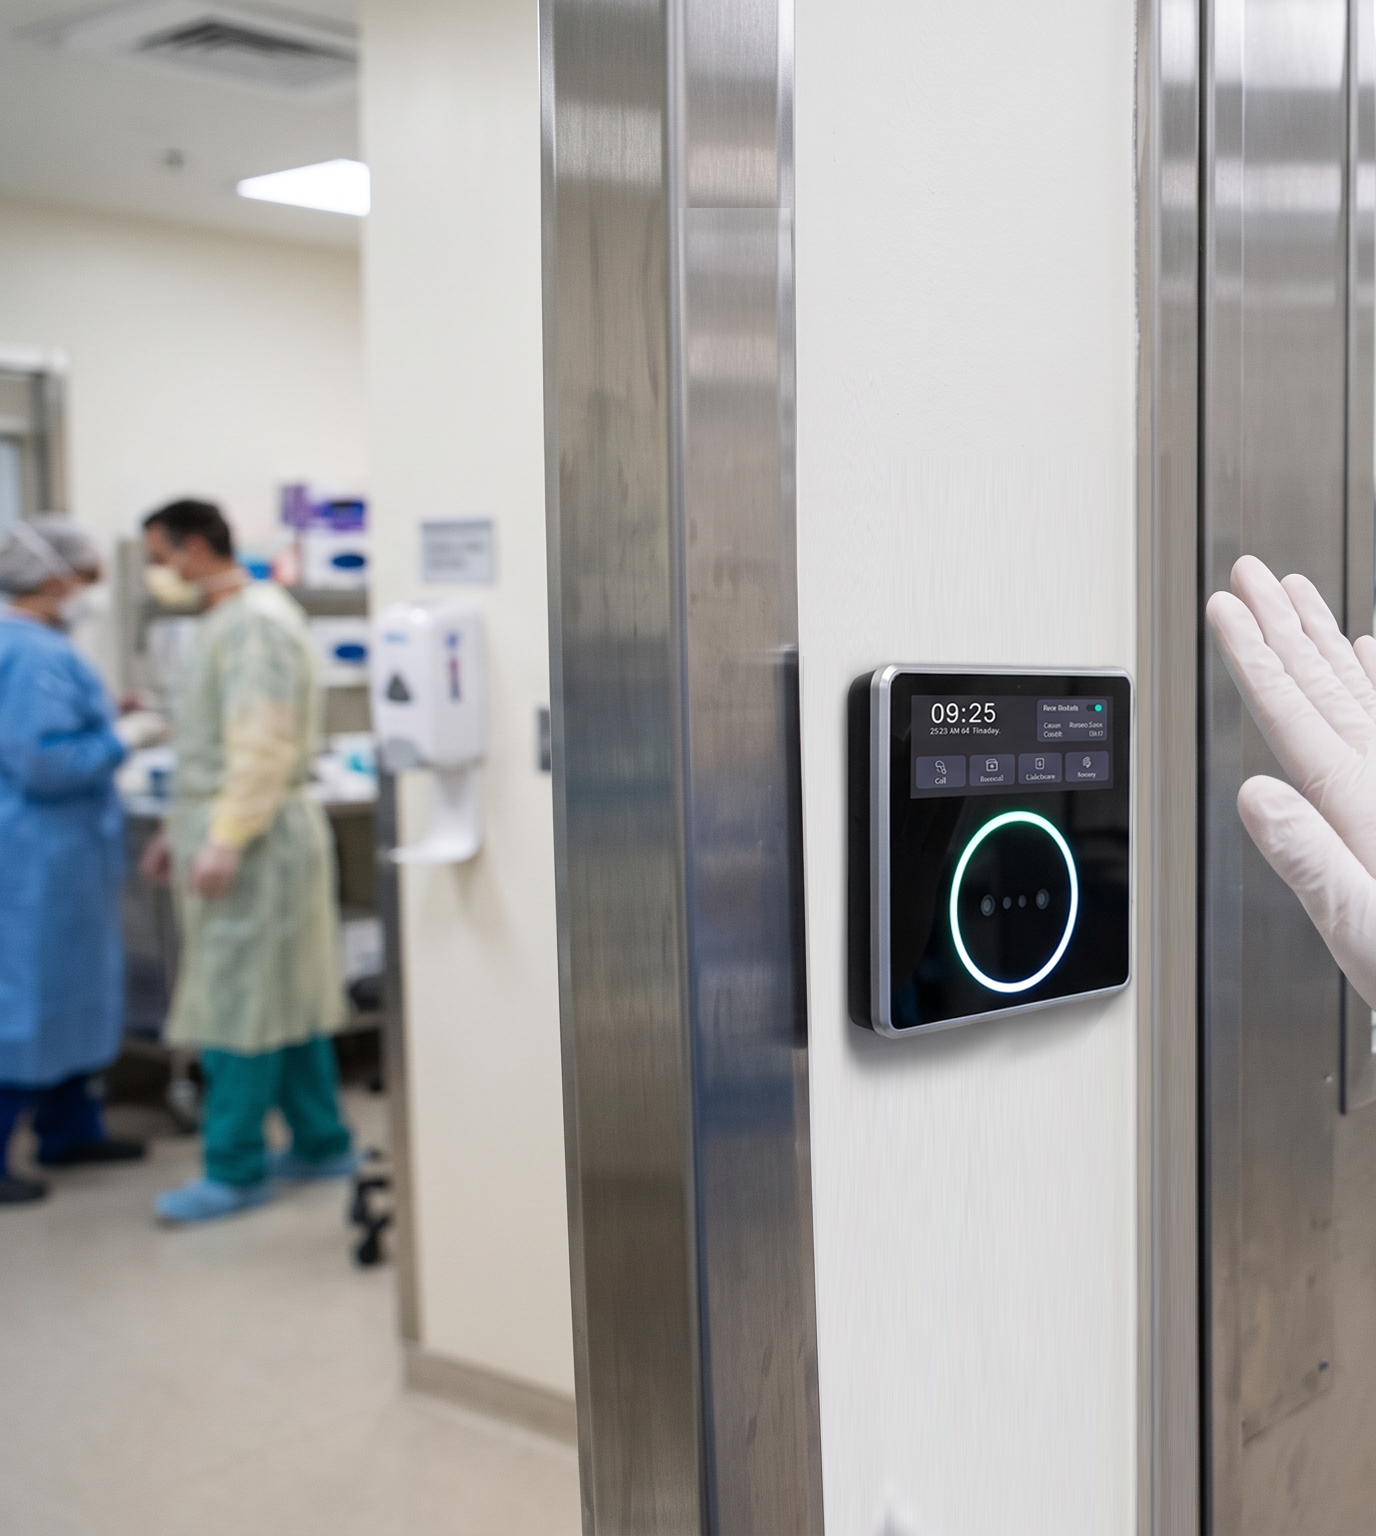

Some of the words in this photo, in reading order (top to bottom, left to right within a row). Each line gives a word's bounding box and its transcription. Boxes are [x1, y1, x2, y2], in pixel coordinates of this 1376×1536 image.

[931, 702, 996, 724] 09:25
[949, 727, 960, 735] AM
[934, 776, 947, 785] Call
